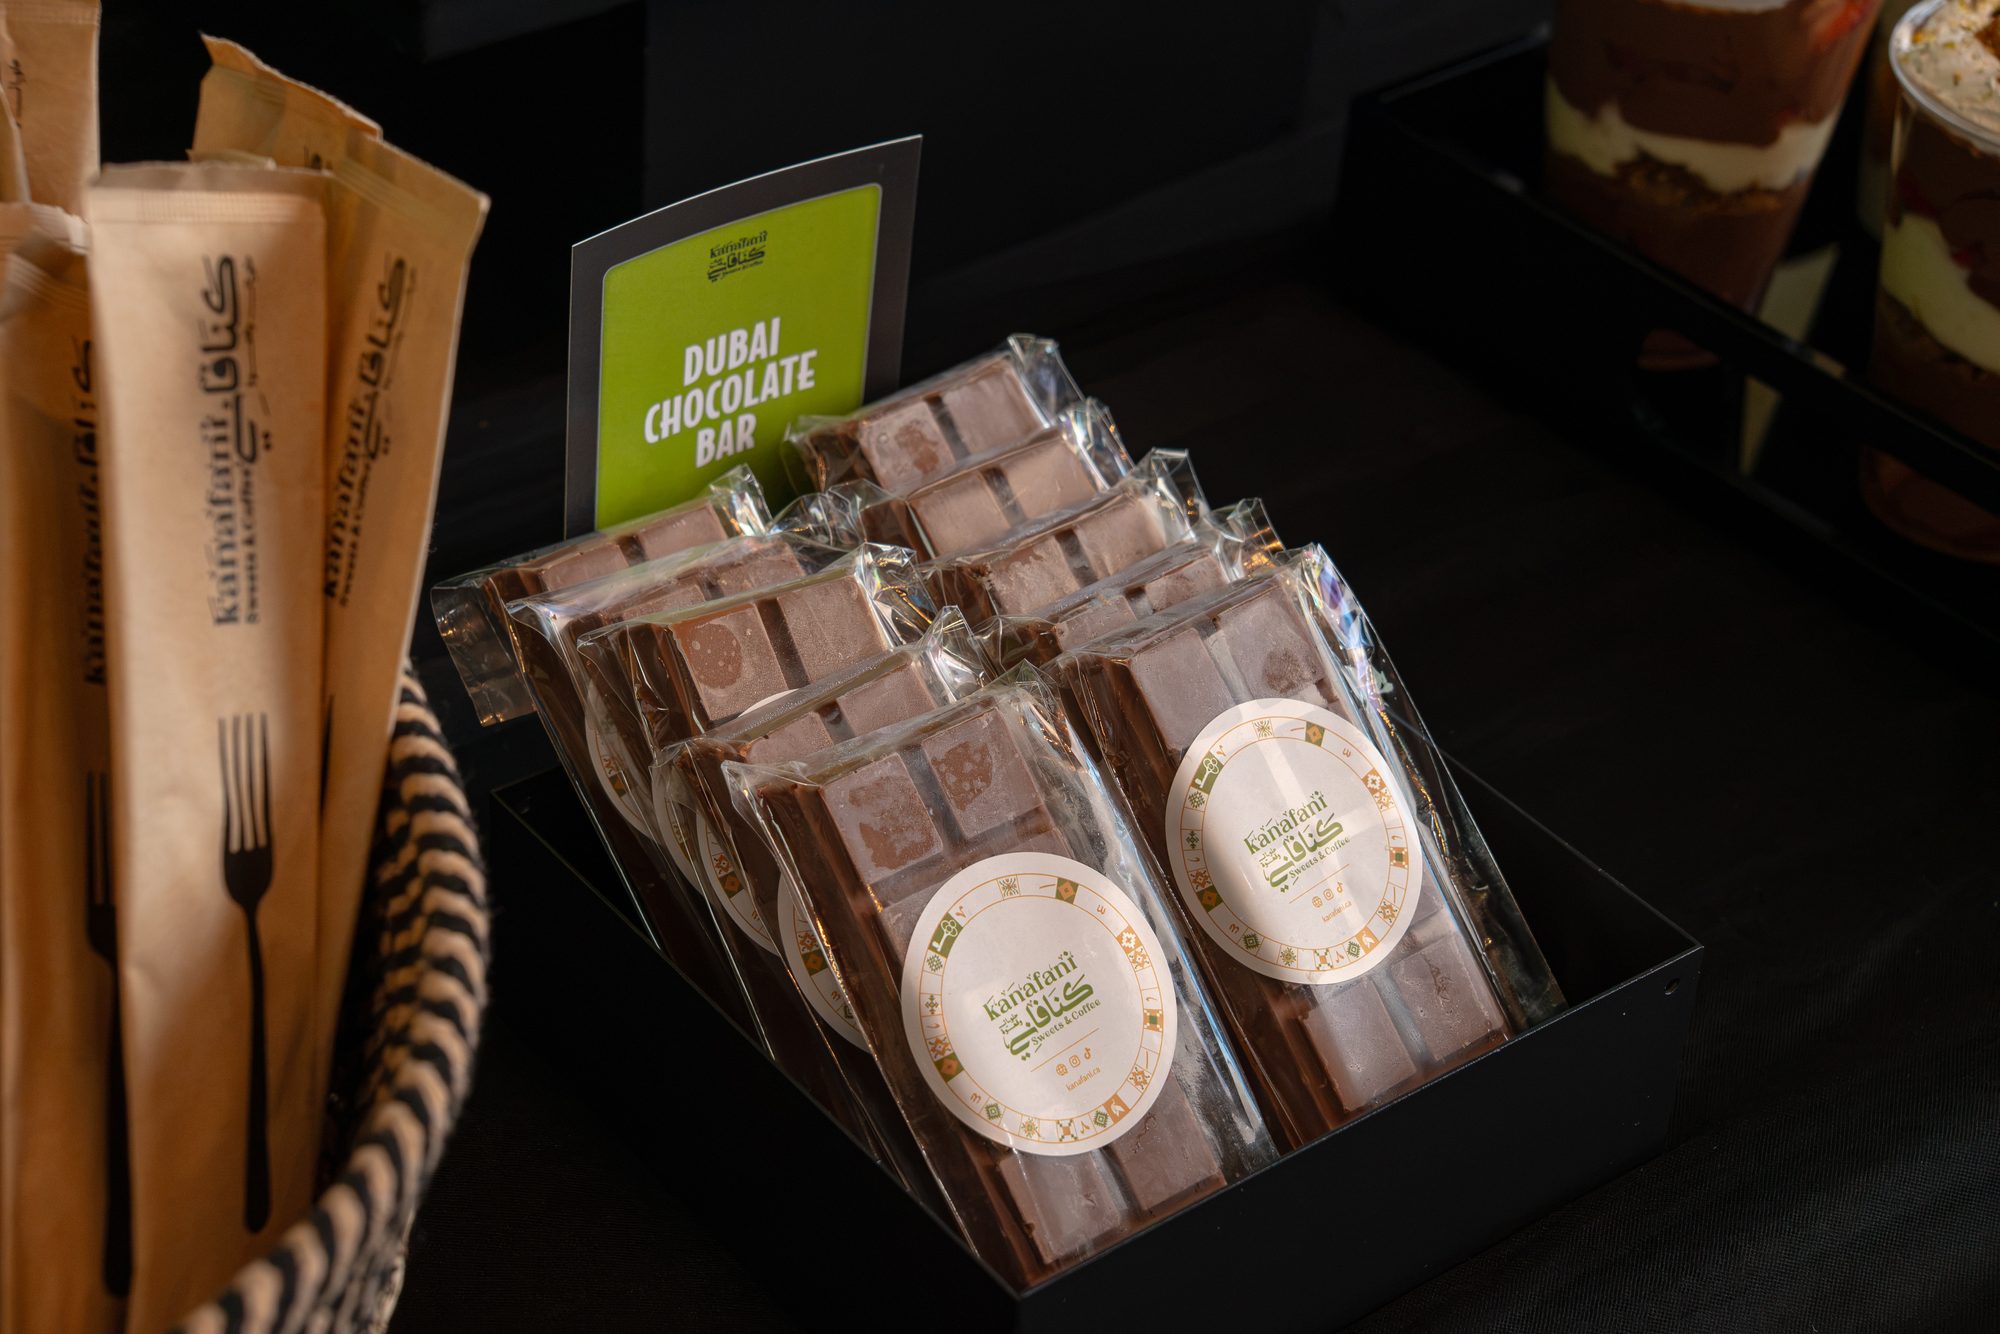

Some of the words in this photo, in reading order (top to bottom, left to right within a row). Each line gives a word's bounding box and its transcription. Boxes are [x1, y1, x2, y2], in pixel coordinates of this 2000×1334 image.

[683, 316, 781, 387] DUBAI
[644, 349, 818, 444] CHOCOLATE
[695, 412, 757, 468] BAR
[1243, 790, 1328, 855] kanafani
[1264, 812, 1344, 893] كنافاني
[1288, 857, 1319, 879] Sweets
[1324, 836, 1352, 856] Coffee
[982, 951, 1078, 1021] kanafani
[1003, 973, 1094, 1061] كنافاني
[1031, 1022, 1065, 1046] Sweets
[1065, 1015, 1074, 1026] &
[1071, 998, 1102, 1021] Coffee
